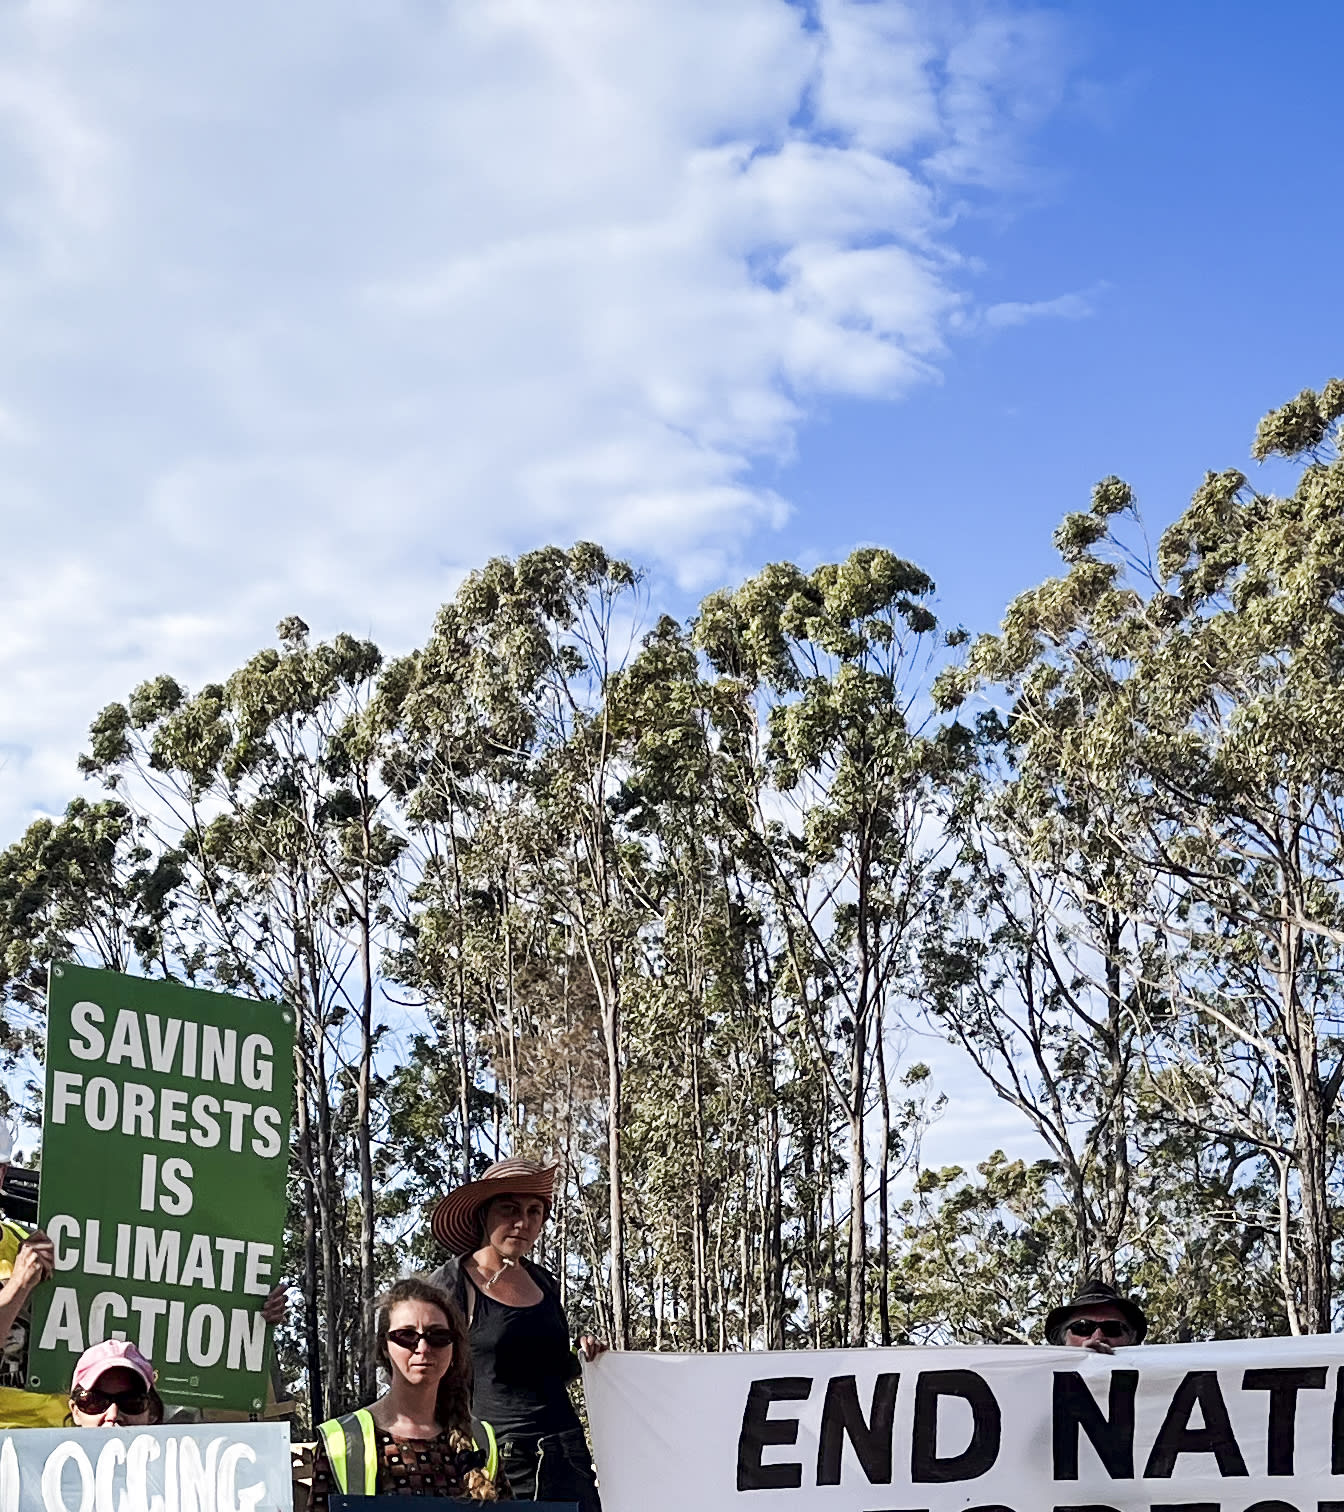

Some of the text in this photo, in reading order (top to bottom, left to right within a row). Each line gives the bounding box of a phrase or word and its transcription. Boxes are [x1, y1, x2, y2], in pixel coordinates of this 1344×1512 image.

[69, 1001, 274, 1092] SAVING
[51, 1070, 282, 1159] FORESTS
[140, 1154, 194, 1216] IS
[46, 1214, 273, 1296] CLIMATE
[38, 1287, 266, 1372] ACTION
[736, 1369, 1002, 1491] END
